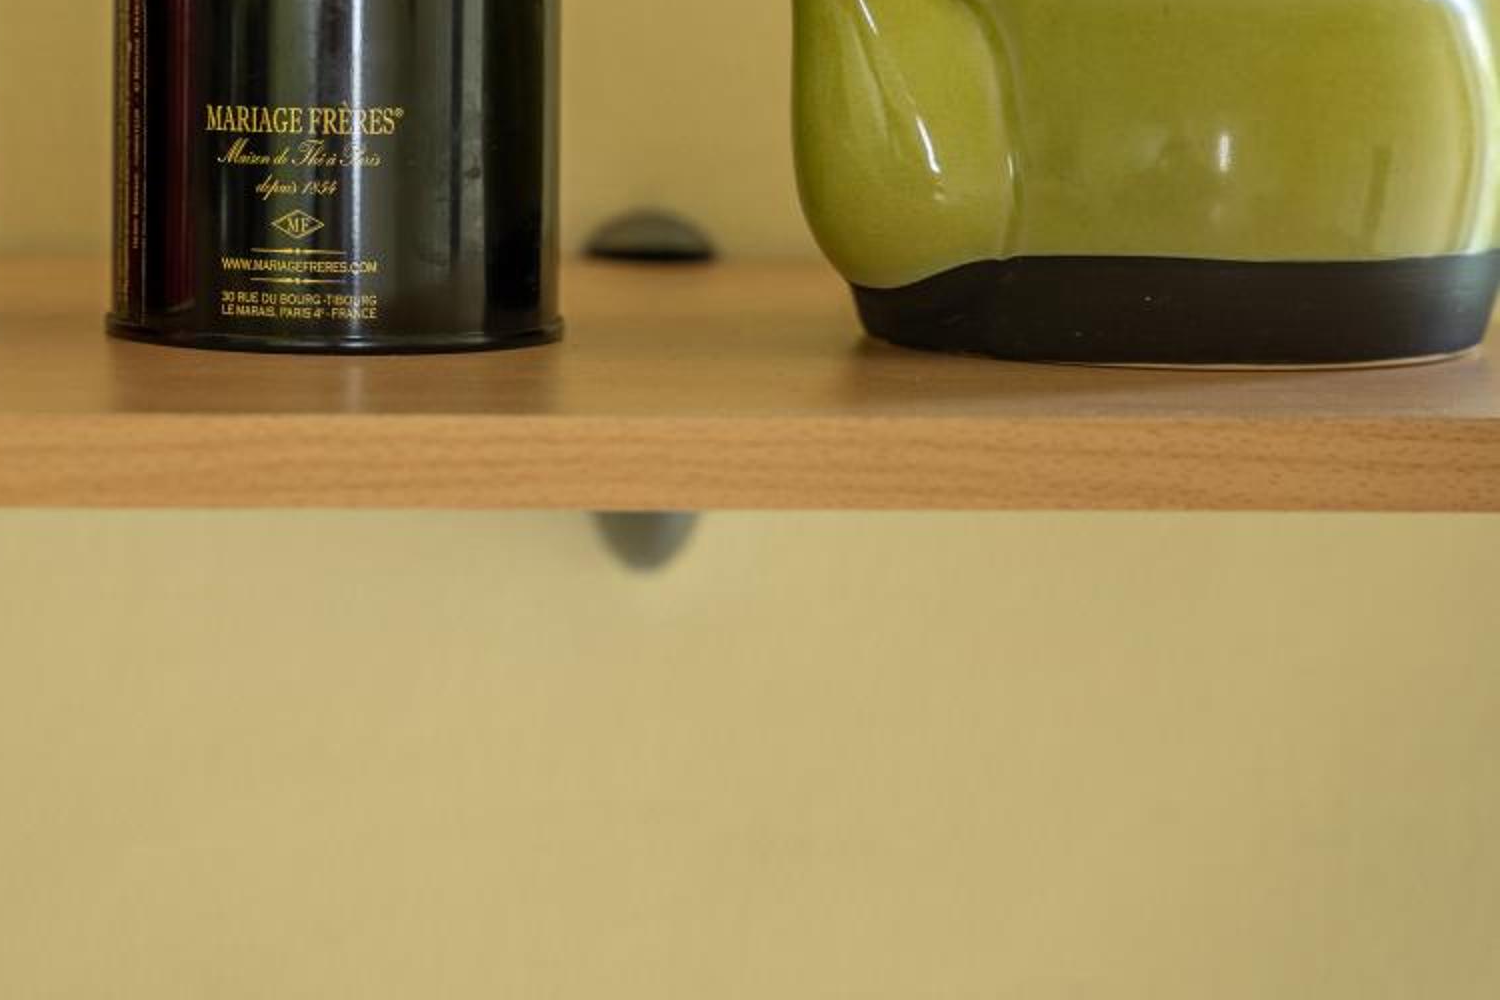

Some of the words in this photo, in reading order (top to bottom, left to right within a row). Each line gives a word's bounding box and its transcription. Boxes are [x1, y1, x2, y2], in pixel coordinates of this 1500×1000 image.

[205, 104, 303, 133] MARIAGE
[217, 137, 270, 165] Maison
[273, 148, 290, 165] de
[301, 180, 339, 195] 1854
[221, 257, 378, 275] WWW.MARIAGEFRERES.COM
[221, 290, 235, 303] 30
[237, 291, 259, 304] RUE
[261, 292, 278, 305] DU
[221, 304, 236, 315] LE
[279, 306, 311, 319] PARIS
[331, 307, 378, 319] FRANCE
